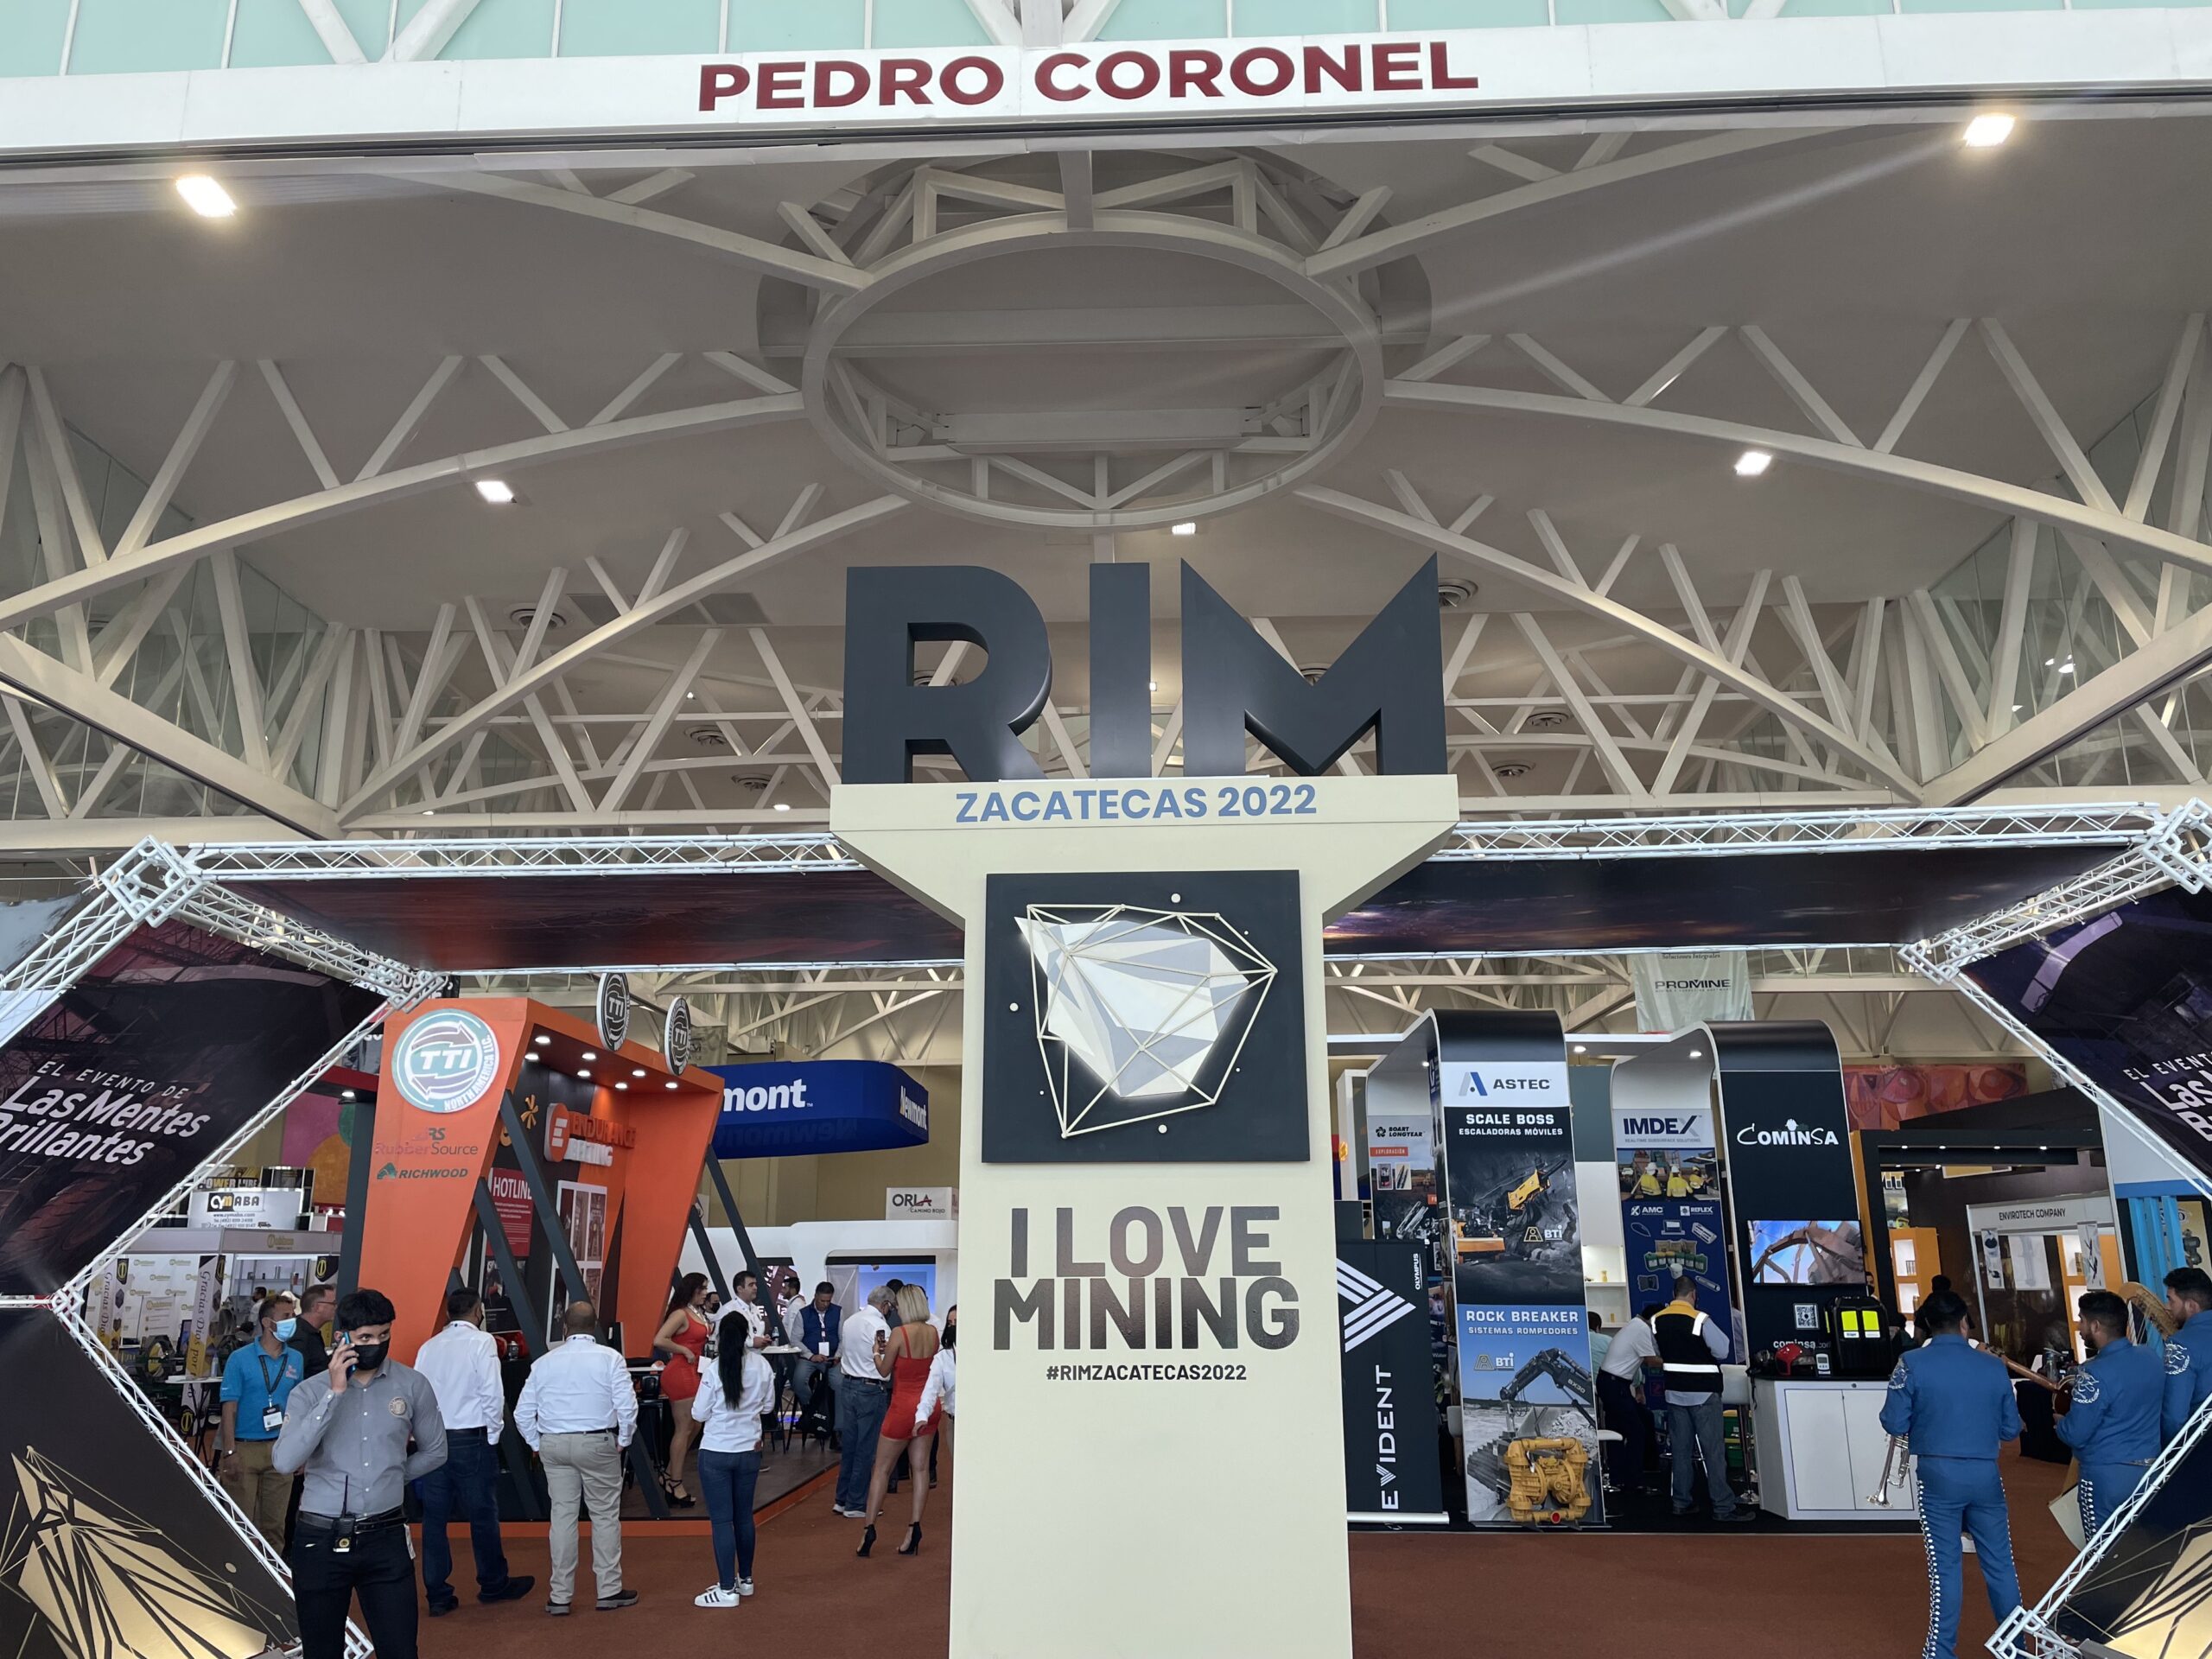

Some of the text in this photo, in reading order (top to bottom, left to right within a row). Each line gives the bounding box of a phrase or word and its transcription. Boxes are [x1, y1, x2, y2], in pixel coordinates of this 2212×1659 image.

[700, 41, 1478, 111] PEDRO CORONEL
[841, 551, 1448, 784] RIM
[955, 784, 1318, 823] ZACATECAS 2022
[1655, 979, 1732, 989] PROMINE
[608, 996, 624, 1018] TTI
[675, 1027, 687, 1046] TTI
[420, 1049, 473, 1070] TTI
[2123, 1052, 2212, 1080] EL EVENT
[36, 1061, 190, 1099] EL EVENTO DE
[443, 1089, 475, 1111] NORTH
[472, 1054, 495, 1094] AMERICA
[1493, 1079, 1550, 1090] ASTEC
[0, 1076, 211, 1138] Las Mentes
[899, 1085, 927, 1130] Newmont
[1465, 1114, 1554, 1125] SCALE BOSS
[1624, 1115, 1700, 1137] IMDEX
[1524, 1127, 1563, 1135] MÓVILES
[398, 1168, 468, 1179] RICHWOOD
[893, 1193, 932, 1208] ORLA
[1999, 1208, 2066, 1221] ENVIROTECH COMPANY
[1011, 1205, 1281, 1278] I LOVE
[103, 1272, 113, 1309] Gracias
[199, 1271, 211, 1318] Gracias
[993, 1276, 1300, 1351] MINING
[1465, 1310, 1579, 1323] ROCK BREAKER
[194, 1318, 206, 1349] Dios
[1468, 1326, 1513, 1335] SISTEMAS
[191, 1348, 200, 1370] por
[1046, 1364, 1247, 1381] #RIMZACATECAS2022
[1376, 1364, 1399, 1510] EVIDENT
